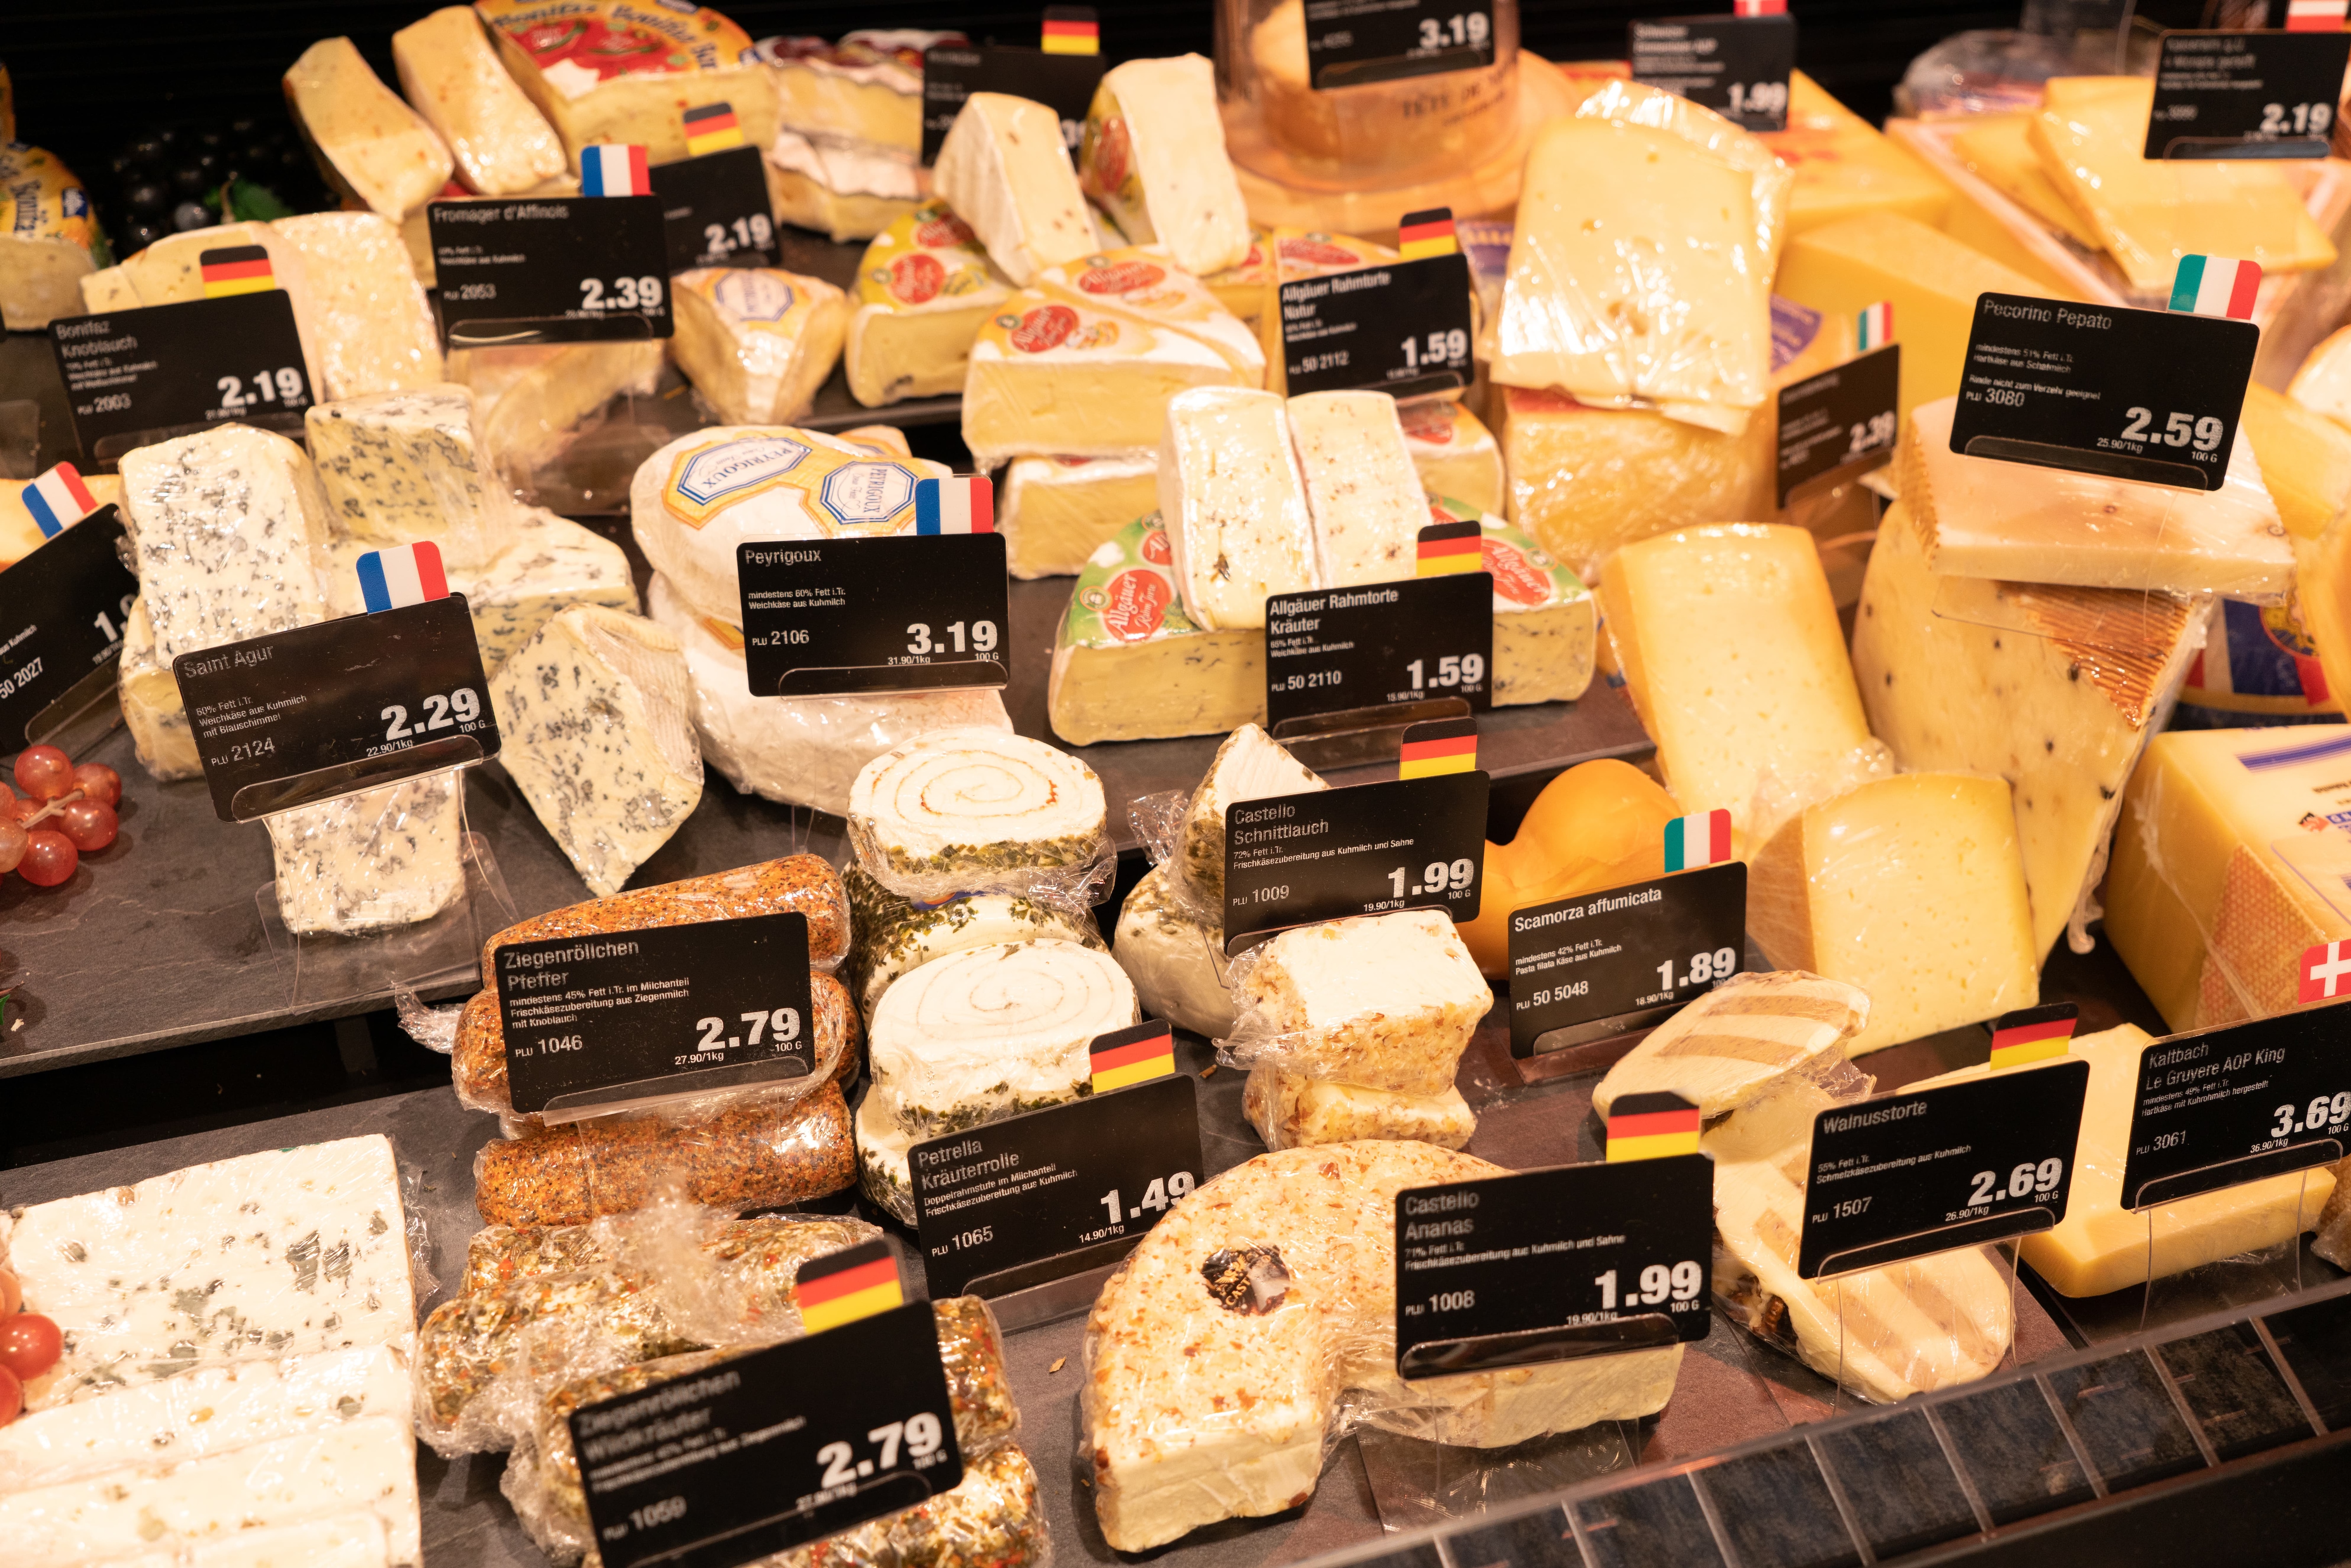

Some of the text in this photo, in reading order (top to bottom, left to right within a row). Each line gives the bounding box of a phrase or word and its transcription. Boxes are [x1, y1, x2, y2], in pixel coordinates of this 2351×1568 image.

[1418, 12, 1489, 51] 3.19
[1724, 82, 1789, 116] 1.99
[2257, 102, 2332, 135] 2.19
[433, 207, 501, 225] Fromager
[704, 213, 772, 256] 2.19
[580, 276, 663, 312] 2.39
[1282, 271, 1391, 303] Allgäuer Rahmtorte
[1283, 304, 1316, 320] Natur
[1984, 299, 2112, 330] Pecorino Pepato
[61, 334, 138, 359] Knoblauch
[1401, 328, 1468, 369] 1.59
[2009, 359, 2025, 368] aus
[217, 367, 303, 409] 2.19
[1965, 387, 2025, 407] PLU 3080
[1992, 378, 2014, 389] nicht
[2014, 382, 2033, 391] zum
[2033, 383, 2064, 395] Verzehr
[1849, 410, 1896, 455] 2.39
[2120, 406, 2224, 452] 2.59
[2096, 437, 2218, 463] 25.90/1kg 100 G
[700, 446, 795, 489] PEYRIGOUX
[863, 468, 888, 514] PEYRIGOUX
[745, 549, 822, 567] Peyrigoux
[1105, 573, 1138, 635] Allgäuer
[1269, 588, 1399, 617] Allgäuer Rahmtorte
[751, 629, 810, 646] PLU 2106
[906, 620, 998, 655] 3.19
[1270, 617, 1320, 635] Kräuter
[183, 645, 274, 678] Saint Agur
[1308, 646, 1322, 654] aus
[1322, 641, 1355, 652] Kuhmilch
[0, 656, 43, 700] 50 2027
[1271, 670, 1342, 692] PLU 50 2110
[1406, 653, 1484, 690] 1.59
[198, 694, 308, 727] Weichkäse aus Kuhmilch
[203, 712, 281, 739] mit Blauschimmel
[380, 687, 481, 741] 2.29
[210, 737, 276, 767] PLU 2124
[366, 719, 487, 758] 22.90/1kg 100 G
[1234, 803, 1296, 825] Castello
[1234, 819, 1329, 845] Schnittlauch
[1233, 838, 1414, 870] Frischkäsezubereitung aus Kuhmilch und Sahne
[1387, 858, 1475, 898] 1.99
[1232, 884, 1290, 906] PLU 1009
[1515, 888, 1662, 932] Scamorza affumicata
[504, 941, 639, 969] Ziegenröllchen
[1515, 938, 1603, 966] mindestens 42% Fett i.Tr.
[1515, 944, 1622, 976] Pasta filata Käse aus Kuhmilch
[507, 971, 569, 992] Pfeffer
[1656, 946, 1736, 992] 1.89
[509, 977, 690, 1007] mindestens 45% Fett i.Tr. im Milchanteil
[510, 988, 689, 1017] Frischkäsezubereitung aus Ziegenmilch
[1516, 980, 1589, 1011] PLU 50 5048
[512, 1013, 578, 1029] mit Knoblauch
[695, 1007, 801, 1052] 2.79
[514, 1034, 583, 1058] PLU 1046
[2148, 1041, 2209, 1069] Kaltbach
[2145, 1048, 2286, 1091] Le Gruyere AOP King
[2141, 1079, 2269, 1117] Hartkäse mit Kuhrohmilch hergestellt
[1823, 1101, 1928, 1134] Walnusstorte
[2270, 1091, 2351, 1138] 3.69
[917, 1140, 983, 1168] Petrella
[2135, 1130, 2186, 1156] PLU 3061
[921, 1152, 1019, 1190] Kräuterrolle
[1816, 1144, 1972, 1185] Schmelzkäsezubereitung aus Kuhmilch
[923, 1163, 1057, 1207] Doppelrahmstufe im Milchanteil
[925, 1169, 1078, 1217] Frischkäsezubereitung aus Kuhmilch
[1100, 1171, 1199, 1225] 1.49
[1967, 1157, 2063, 1207] 2.69
[1404, 1191, 1480, 1216] Castello
[1812, 1196, 1872, 1224] PLU 1507
[931, 1225, 994, 1257] PLU 1065
[1079, 1224, 1125, 1244] 14.90/1kg
[1404, 1218, 1474, 1241] Ananas
[1404, 1234, 1626, 1270] Frischkäsezubereitung aus Kuhmilch und Sahne
[1225, 1274, 1251, 1306] CAST
[1594, 1260, 1703, 1310] 1.99
[1405, 1289, 1475, 1316] PLU 1008
[816, 1411, 944, 1490] 2.79
